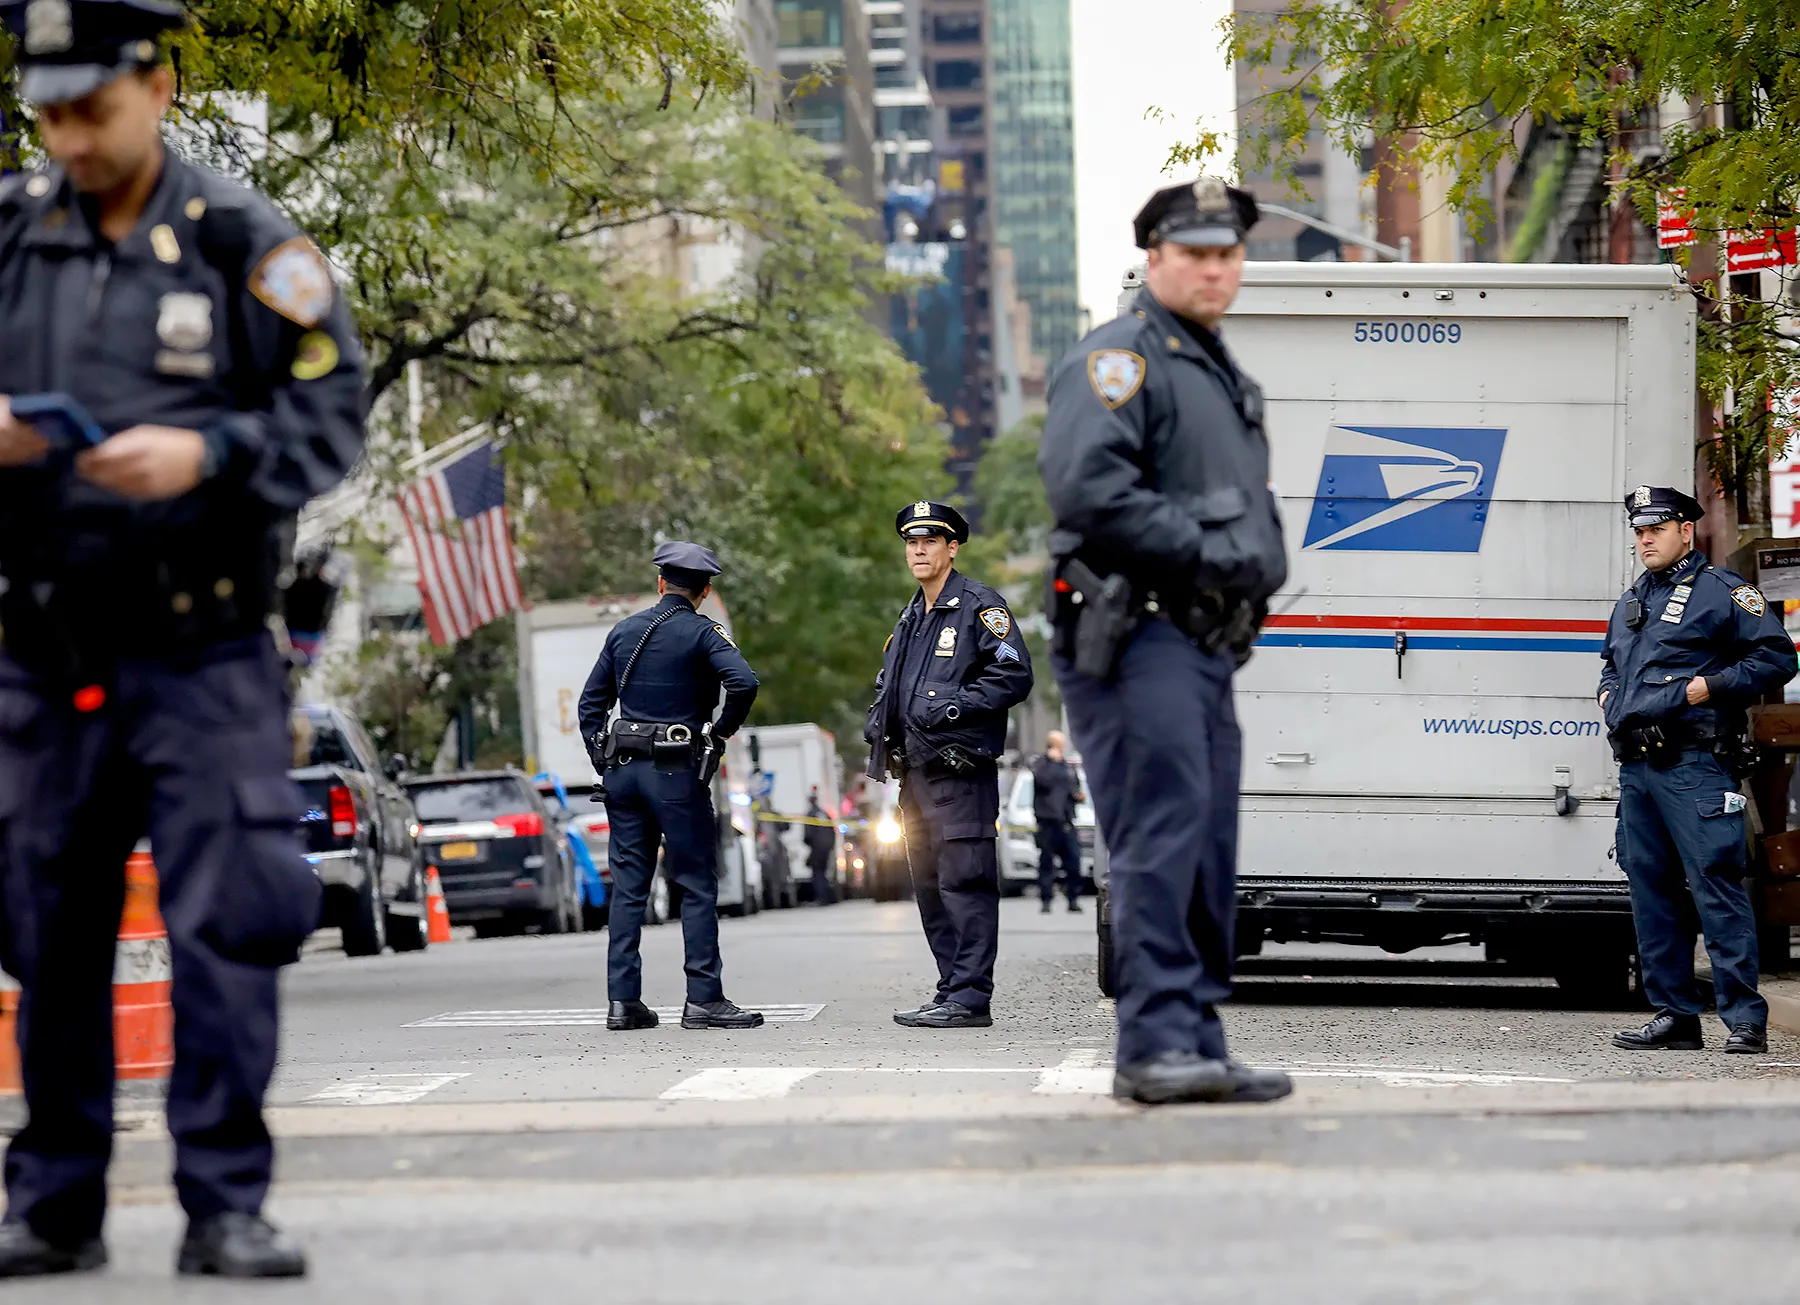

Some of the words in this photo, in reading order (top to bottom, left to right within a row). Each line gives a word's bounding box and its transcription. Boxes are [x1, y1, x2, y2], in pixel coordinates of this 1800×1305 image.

[1354, 322, 1462, 343] 5500069
[1776, 557, 1789, 565] NO
[1423, 718, 1600, 739] www.usps.com
